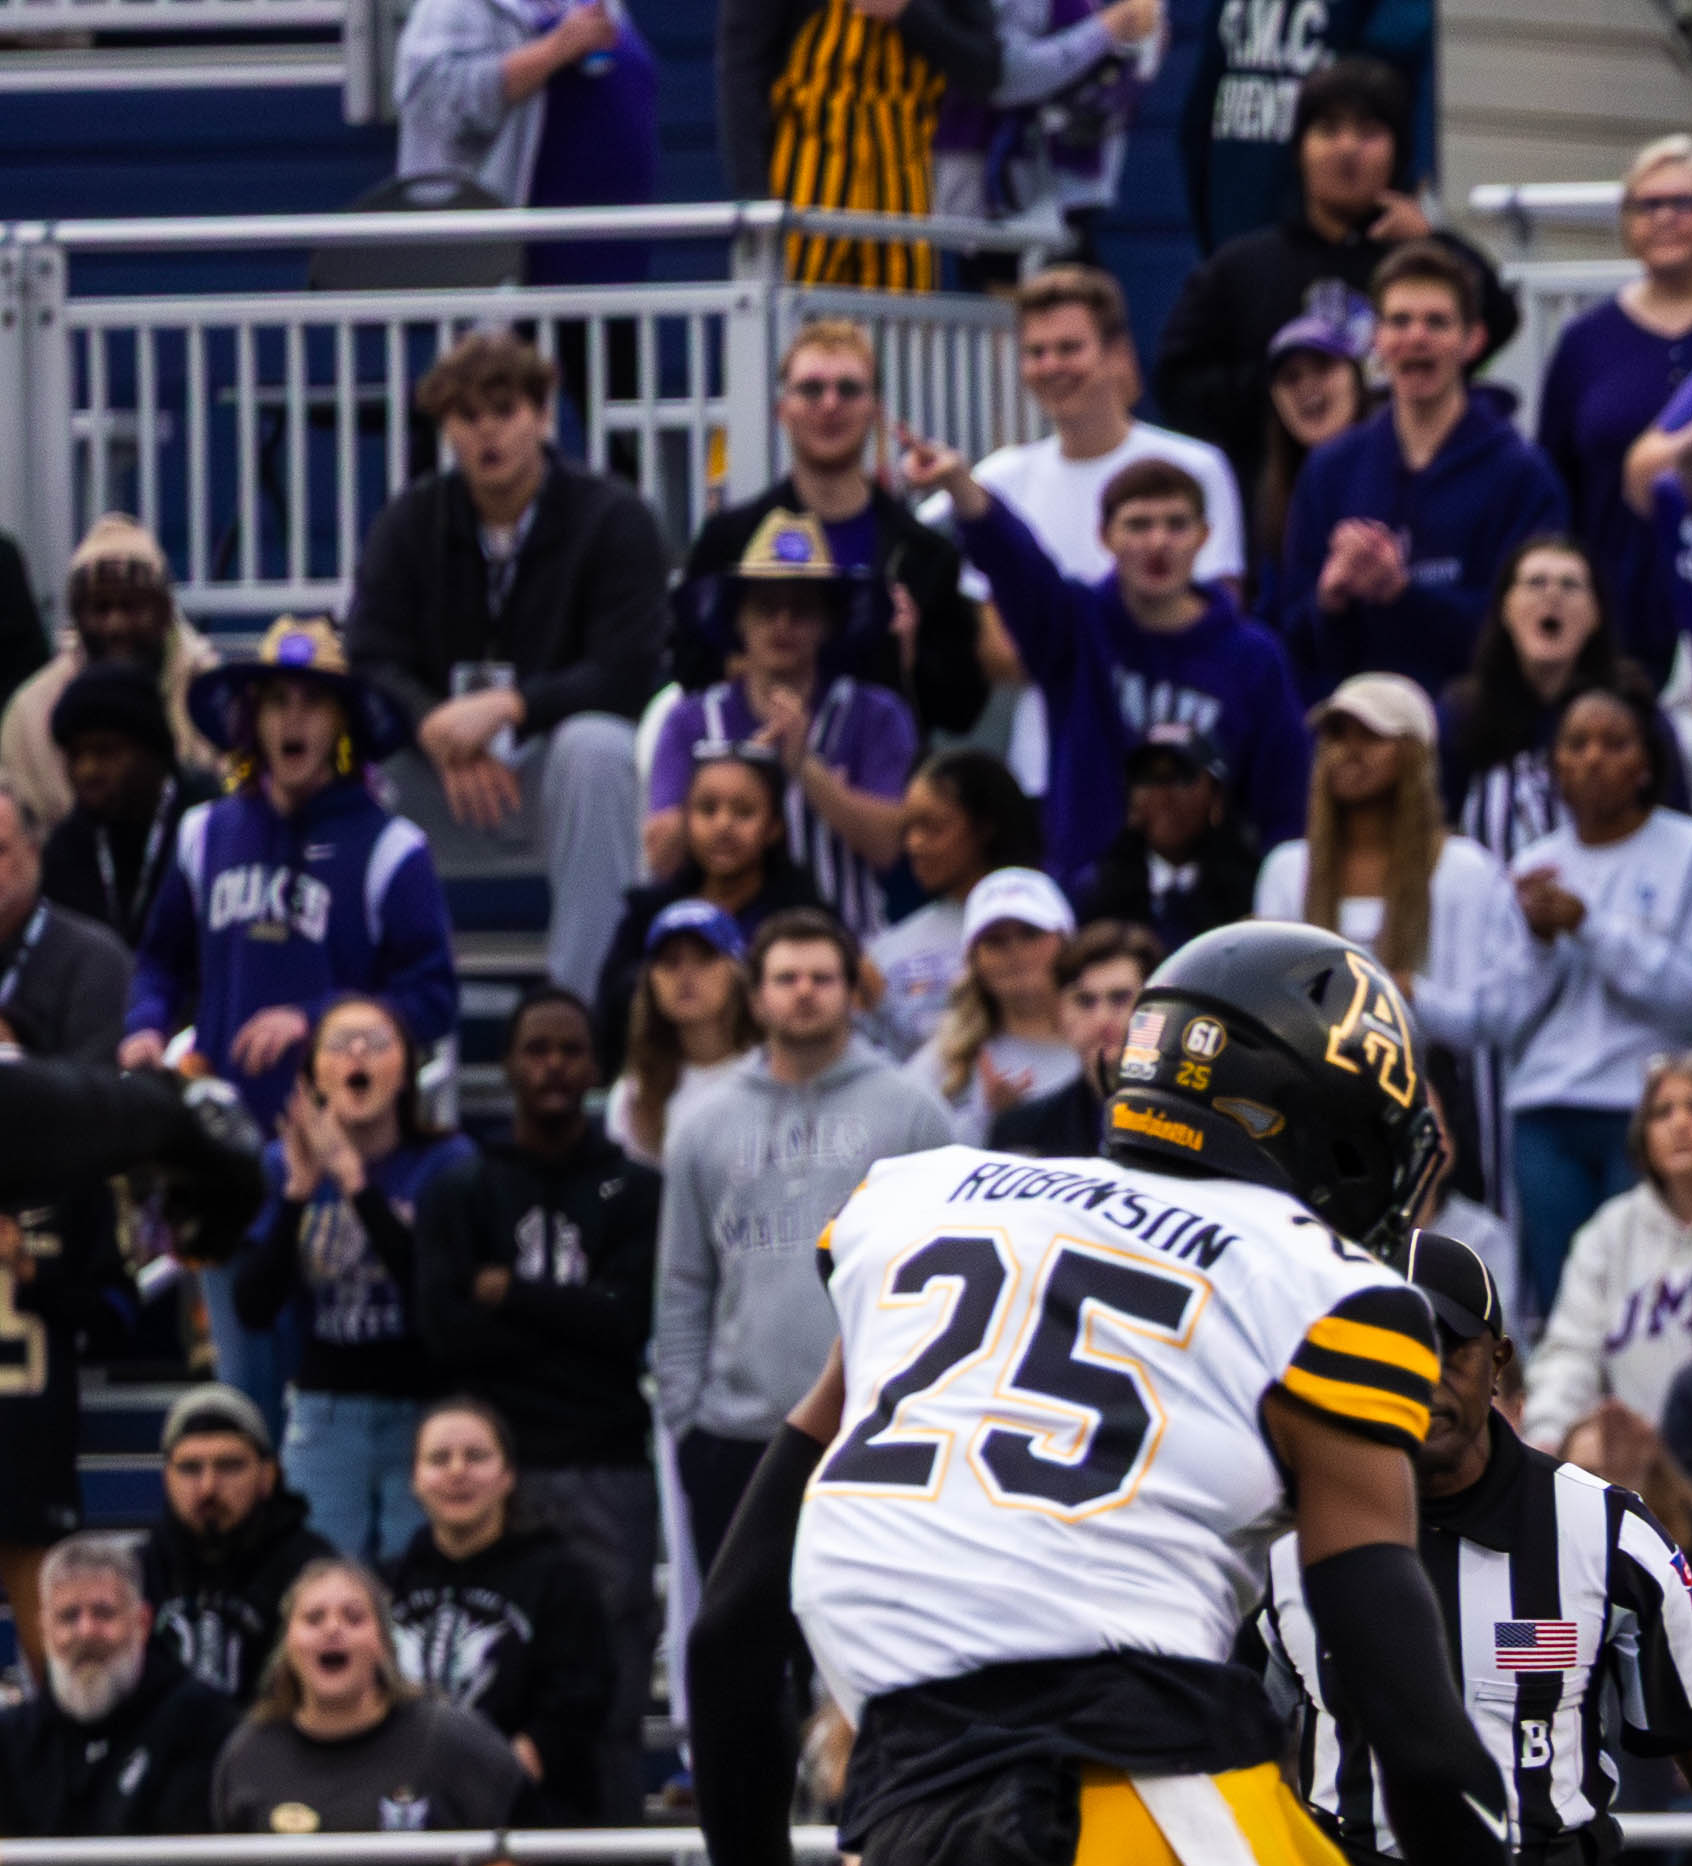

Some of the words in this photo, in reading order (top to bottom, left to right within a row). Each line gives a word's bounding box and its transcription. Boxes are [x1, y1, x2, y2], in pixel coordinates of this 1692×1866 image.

[1184, 1020, 1221, 1058] 61
[1175, 1060, 1213, 1092] 25
[948, 1160, 1242, 1272] ROBINSON
[805, 1226, 1214, 1524] 25
[1520, 1719, 1552, 1768] B
